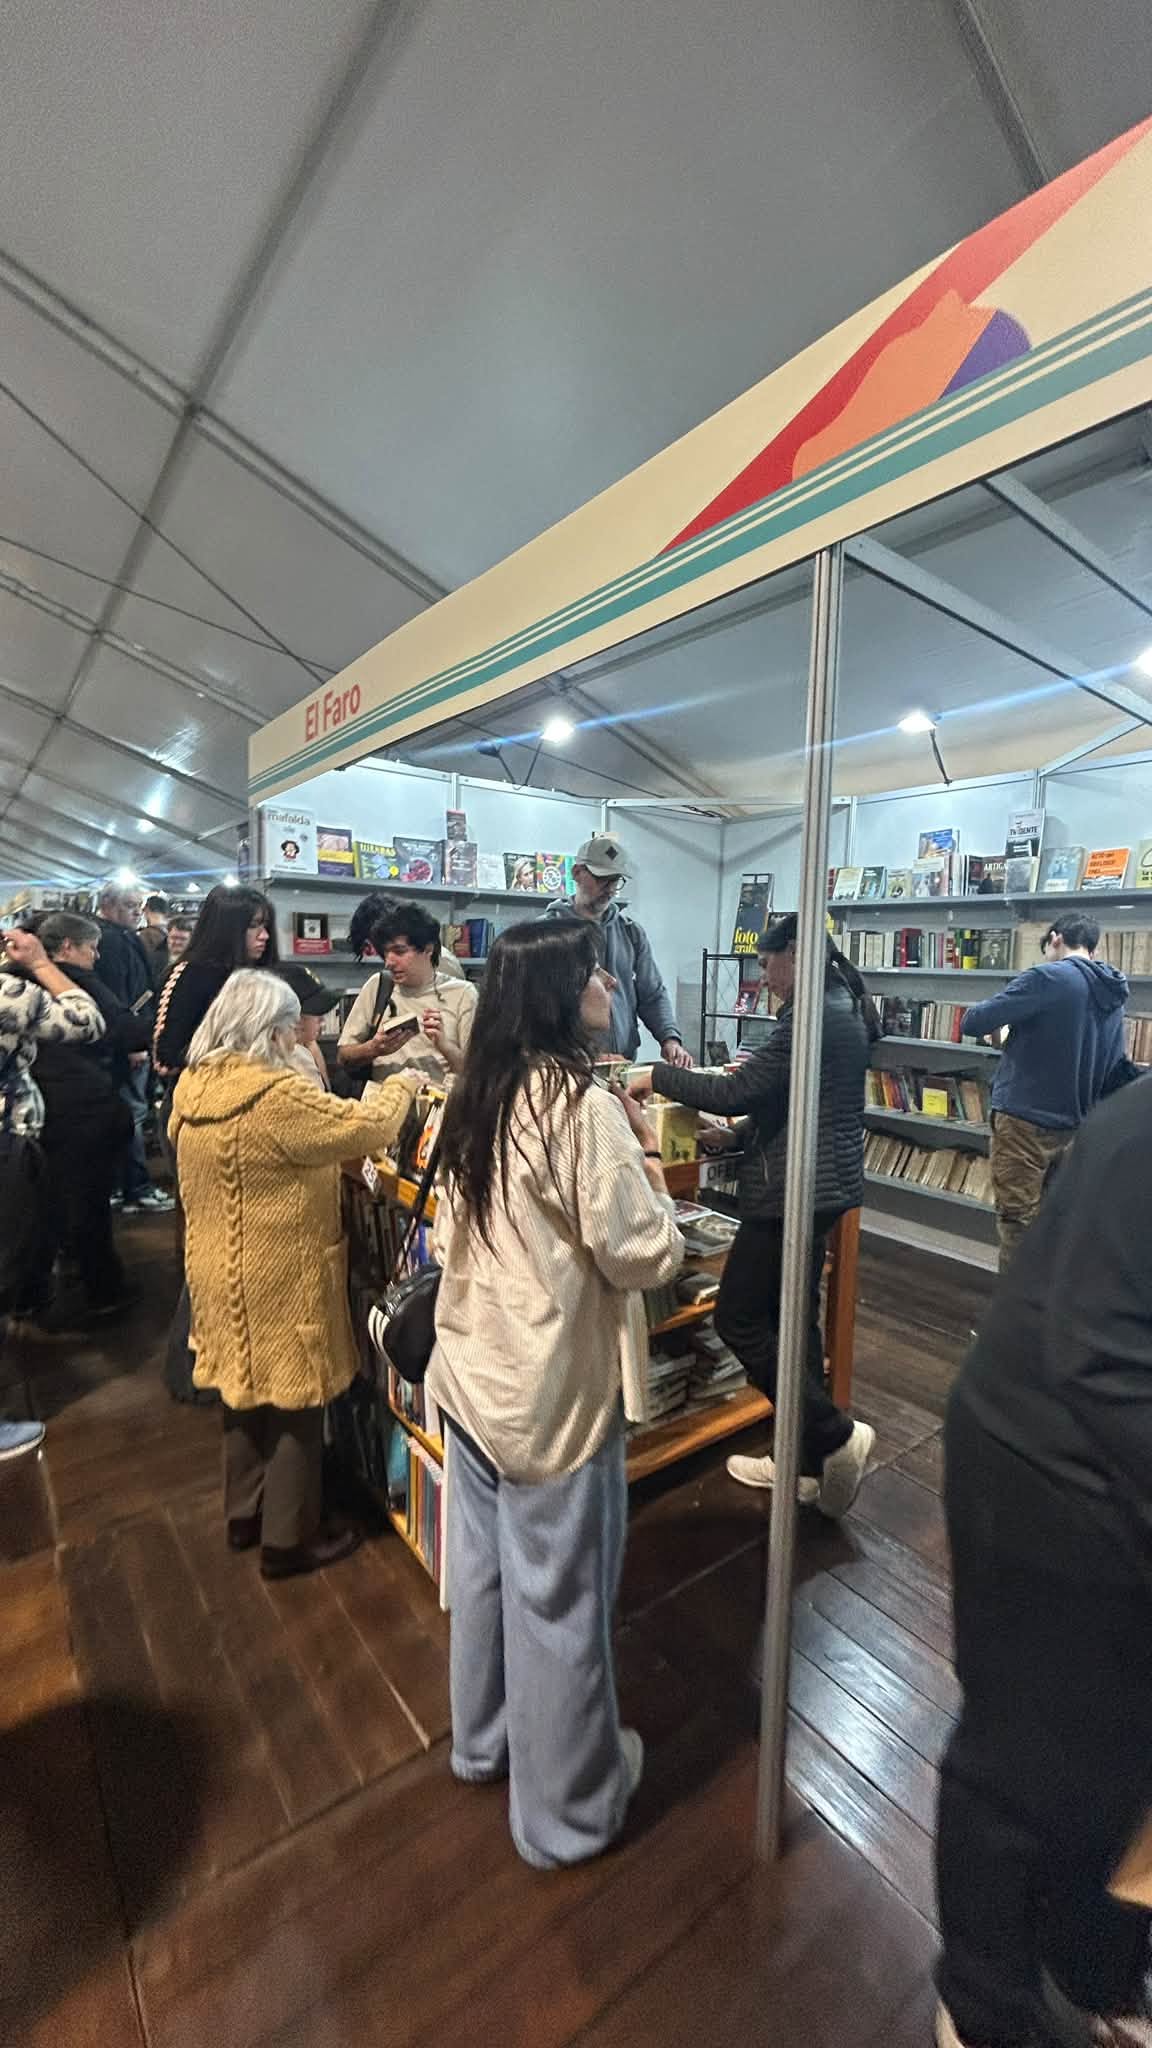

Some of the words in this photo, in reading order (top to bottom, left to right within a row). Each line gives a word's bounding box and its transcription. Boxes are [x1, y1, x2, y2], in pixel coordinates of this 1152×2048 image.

[305, 701, 318, 742] El
[323, 684, 361, 731] Faro
[735, 926, 758, 945] foto
